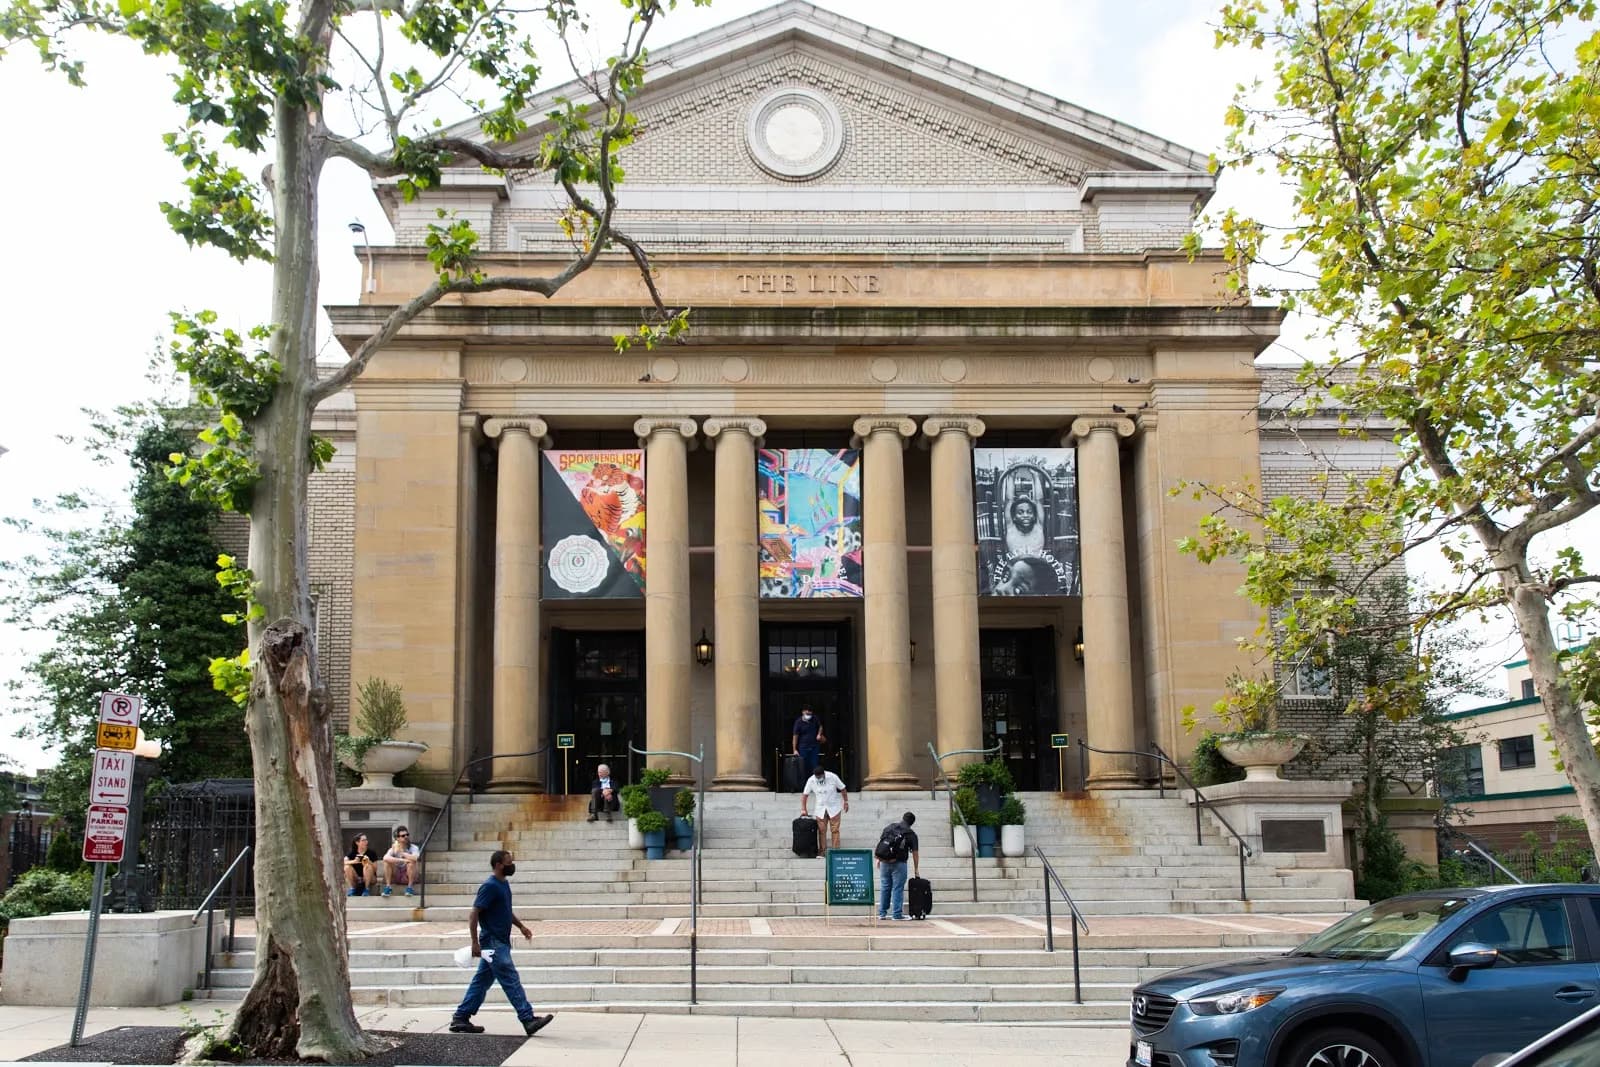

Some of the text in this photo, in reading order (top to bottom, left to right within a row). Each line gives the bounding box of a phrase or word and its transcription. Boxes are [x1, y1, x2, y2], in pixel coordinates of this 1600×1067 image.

[737, 274, 880, 293] THE LINE
[993, 558, 1007, 582] THE
[1038, 549, 1066, 582] HOTEL
[791, 658, 818, 668] 1770
[101, 757, 125, 771] TAXI
[97, 777, 126, 788] STAND
